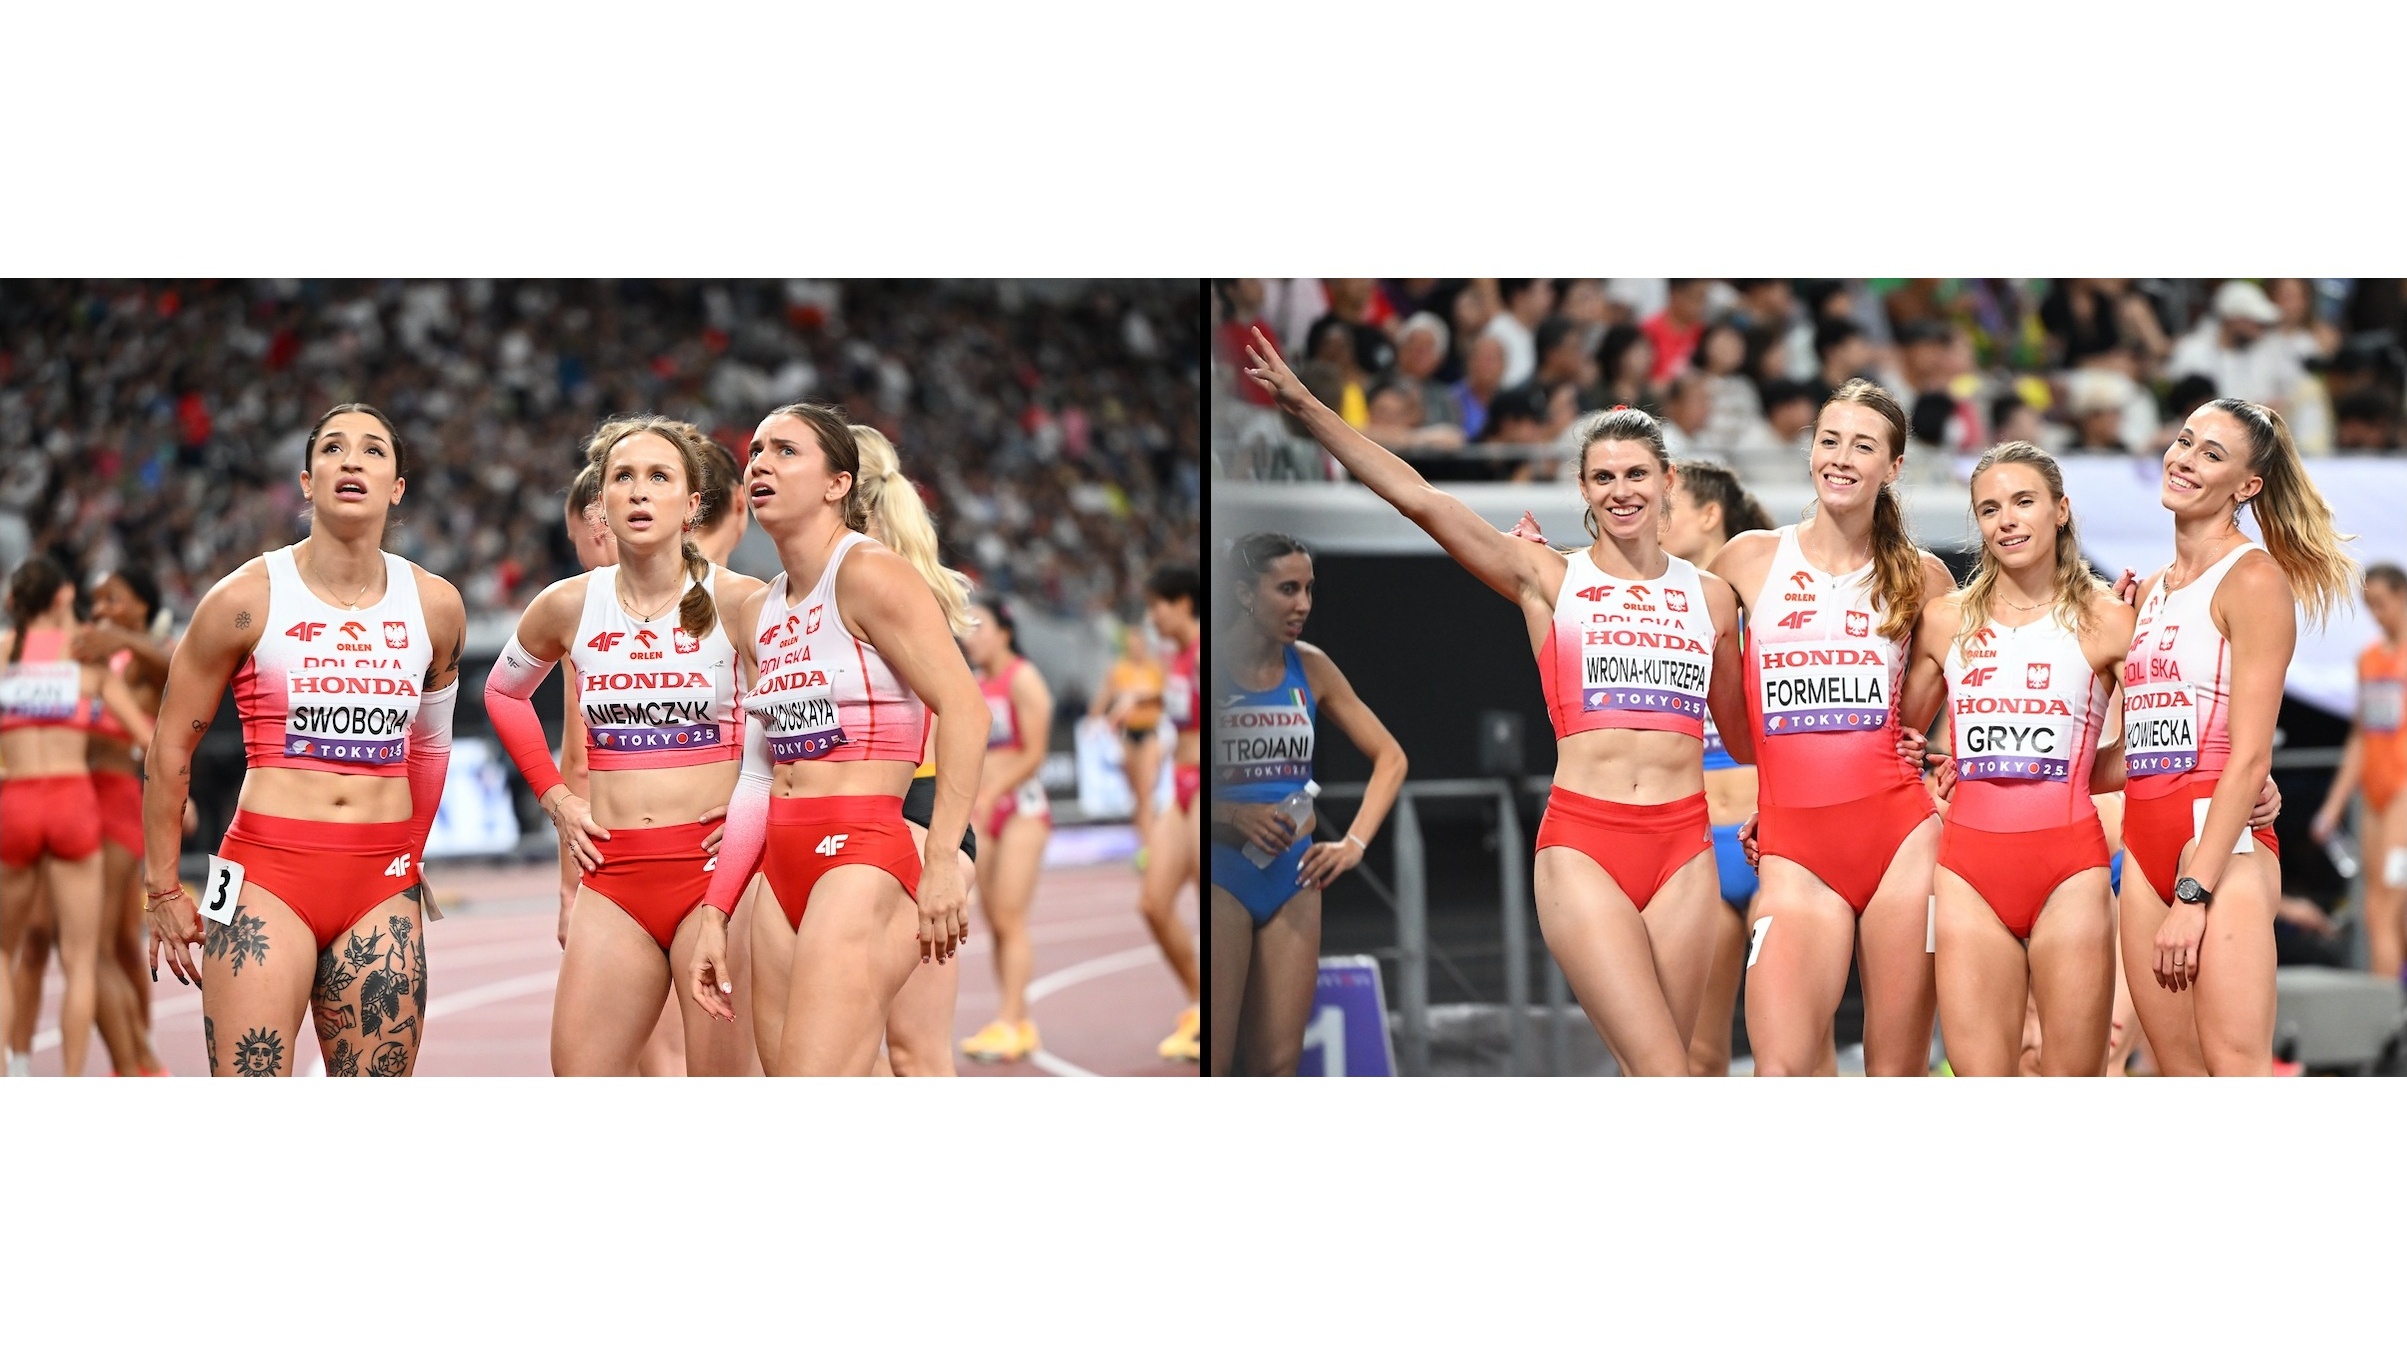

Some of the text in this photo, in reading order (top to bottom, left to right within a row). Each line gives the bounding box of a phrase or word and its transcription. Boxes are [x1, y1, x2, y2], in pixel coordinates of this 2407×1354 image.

[1575, 585, 1615, 601] 4F
[1784, 593, 1815, 602] ORLEN
[1623, 603, 1656, 612] ORLEN
[1777, 610, 1818, 629] 4F
[285, 621, 327, 642] 4F
[587, 631, 626, 652] 4F
[759, 624, 781, 646] 4F
[779, 635, 799, 649] ORLEN
[336, 643, 372, 651] ORLEN
[1585, 630, 1710, 655] HONDA
[629, 651, 663, 660] ORLEN
[1762, 649, 1885, 670] HONDA
[585, 672, 713, 692] HONDA
[1586, 656, 1706, 692] WRONA-KUTRZEPA
[1961, 667, 1998, 687] 4F
[291, 676, 418, 697] HONDA
[1766, 677, 1883, 708] FORMELLA
[586, 701, 710, 726] NIEMCZYK
[1956, 698, 2072, 717] HONDA
[1219, 712, 1310, 728] HONDA
[1222, 736, 1309, 761] TROIANI
[1967, 725, 2056, 753] GRYC
[814, 833, 849, 857] 4F
[384, 853, 411, 877] 4F
[209, 868, 232, 912] 3
[1303, 1004, 1347, 1077] 1
